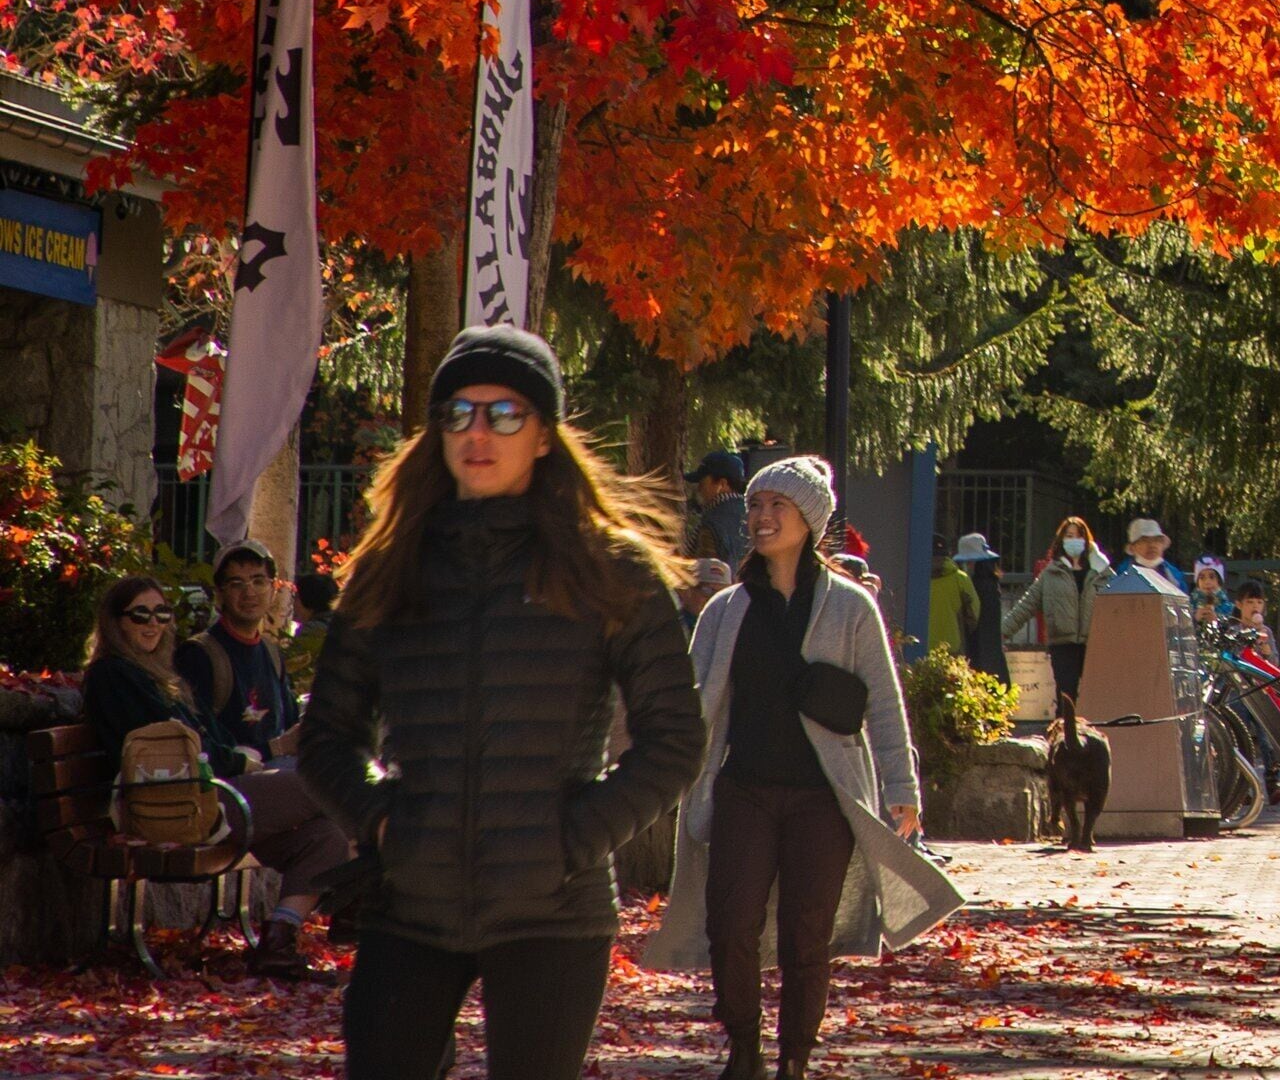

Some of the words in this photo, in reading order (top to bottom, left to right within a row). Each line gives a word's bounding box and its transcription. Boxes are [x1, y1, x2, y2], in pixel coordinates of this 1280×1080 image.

[24, 224, 44, 261] ICE
[45, 230, 86, 271] CREAM
[474, 49, 524, 328] ILLABONG
